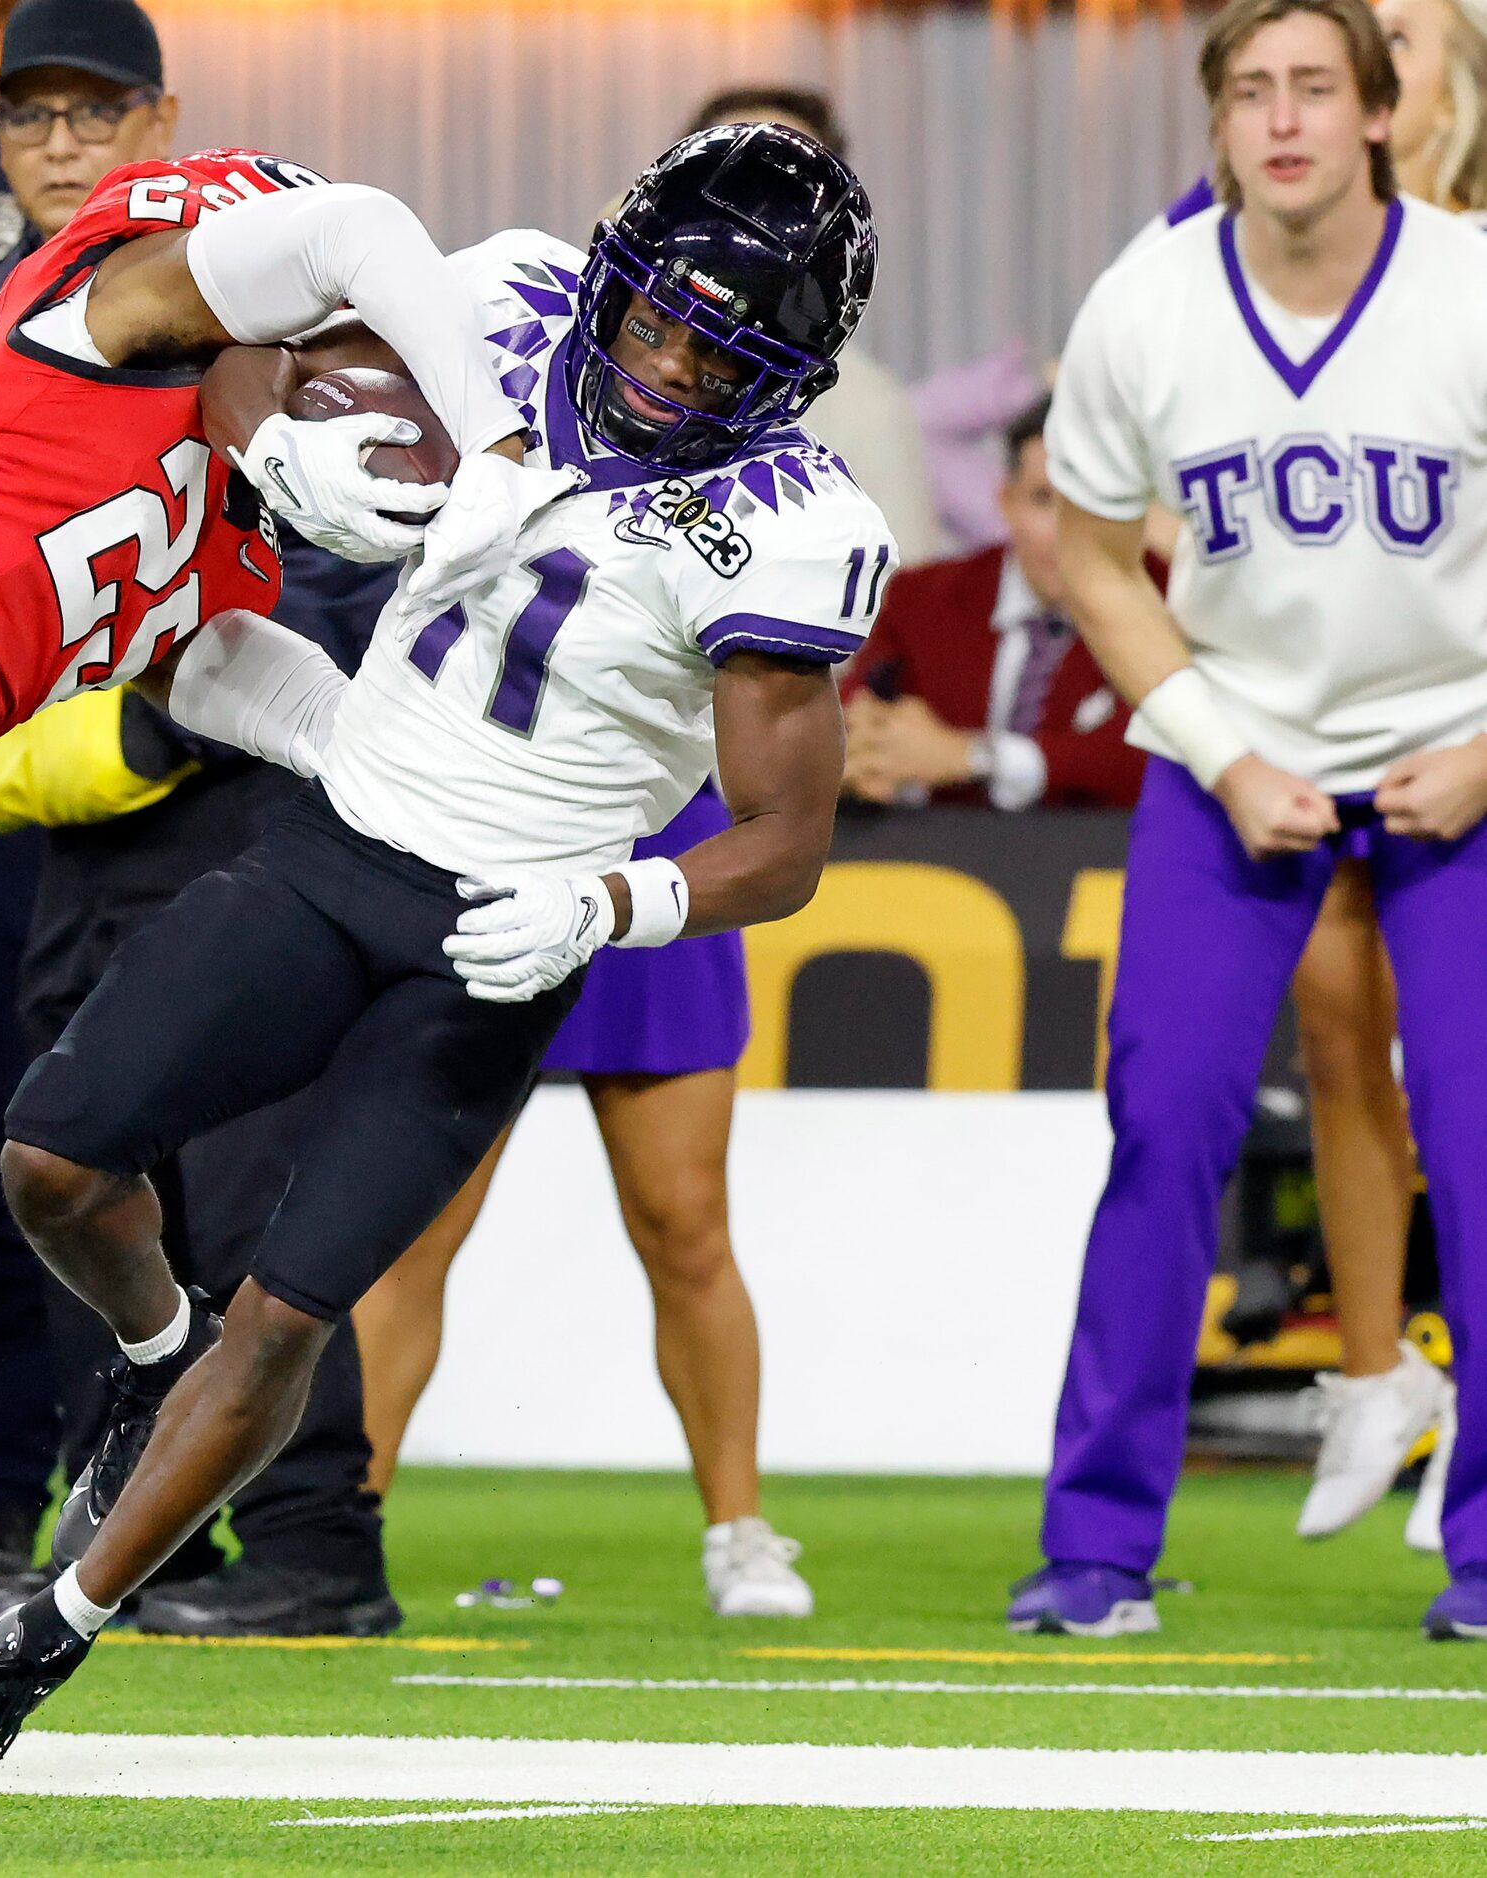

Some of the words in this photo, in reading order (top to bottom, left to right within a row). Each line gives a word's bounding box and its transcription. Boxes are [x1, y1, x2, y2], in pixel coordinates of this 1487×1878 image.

[688, 269, 734, 302] schutt
[1169, 431, 1462, 566] TCU
[838, 544, 889, 621] 11
